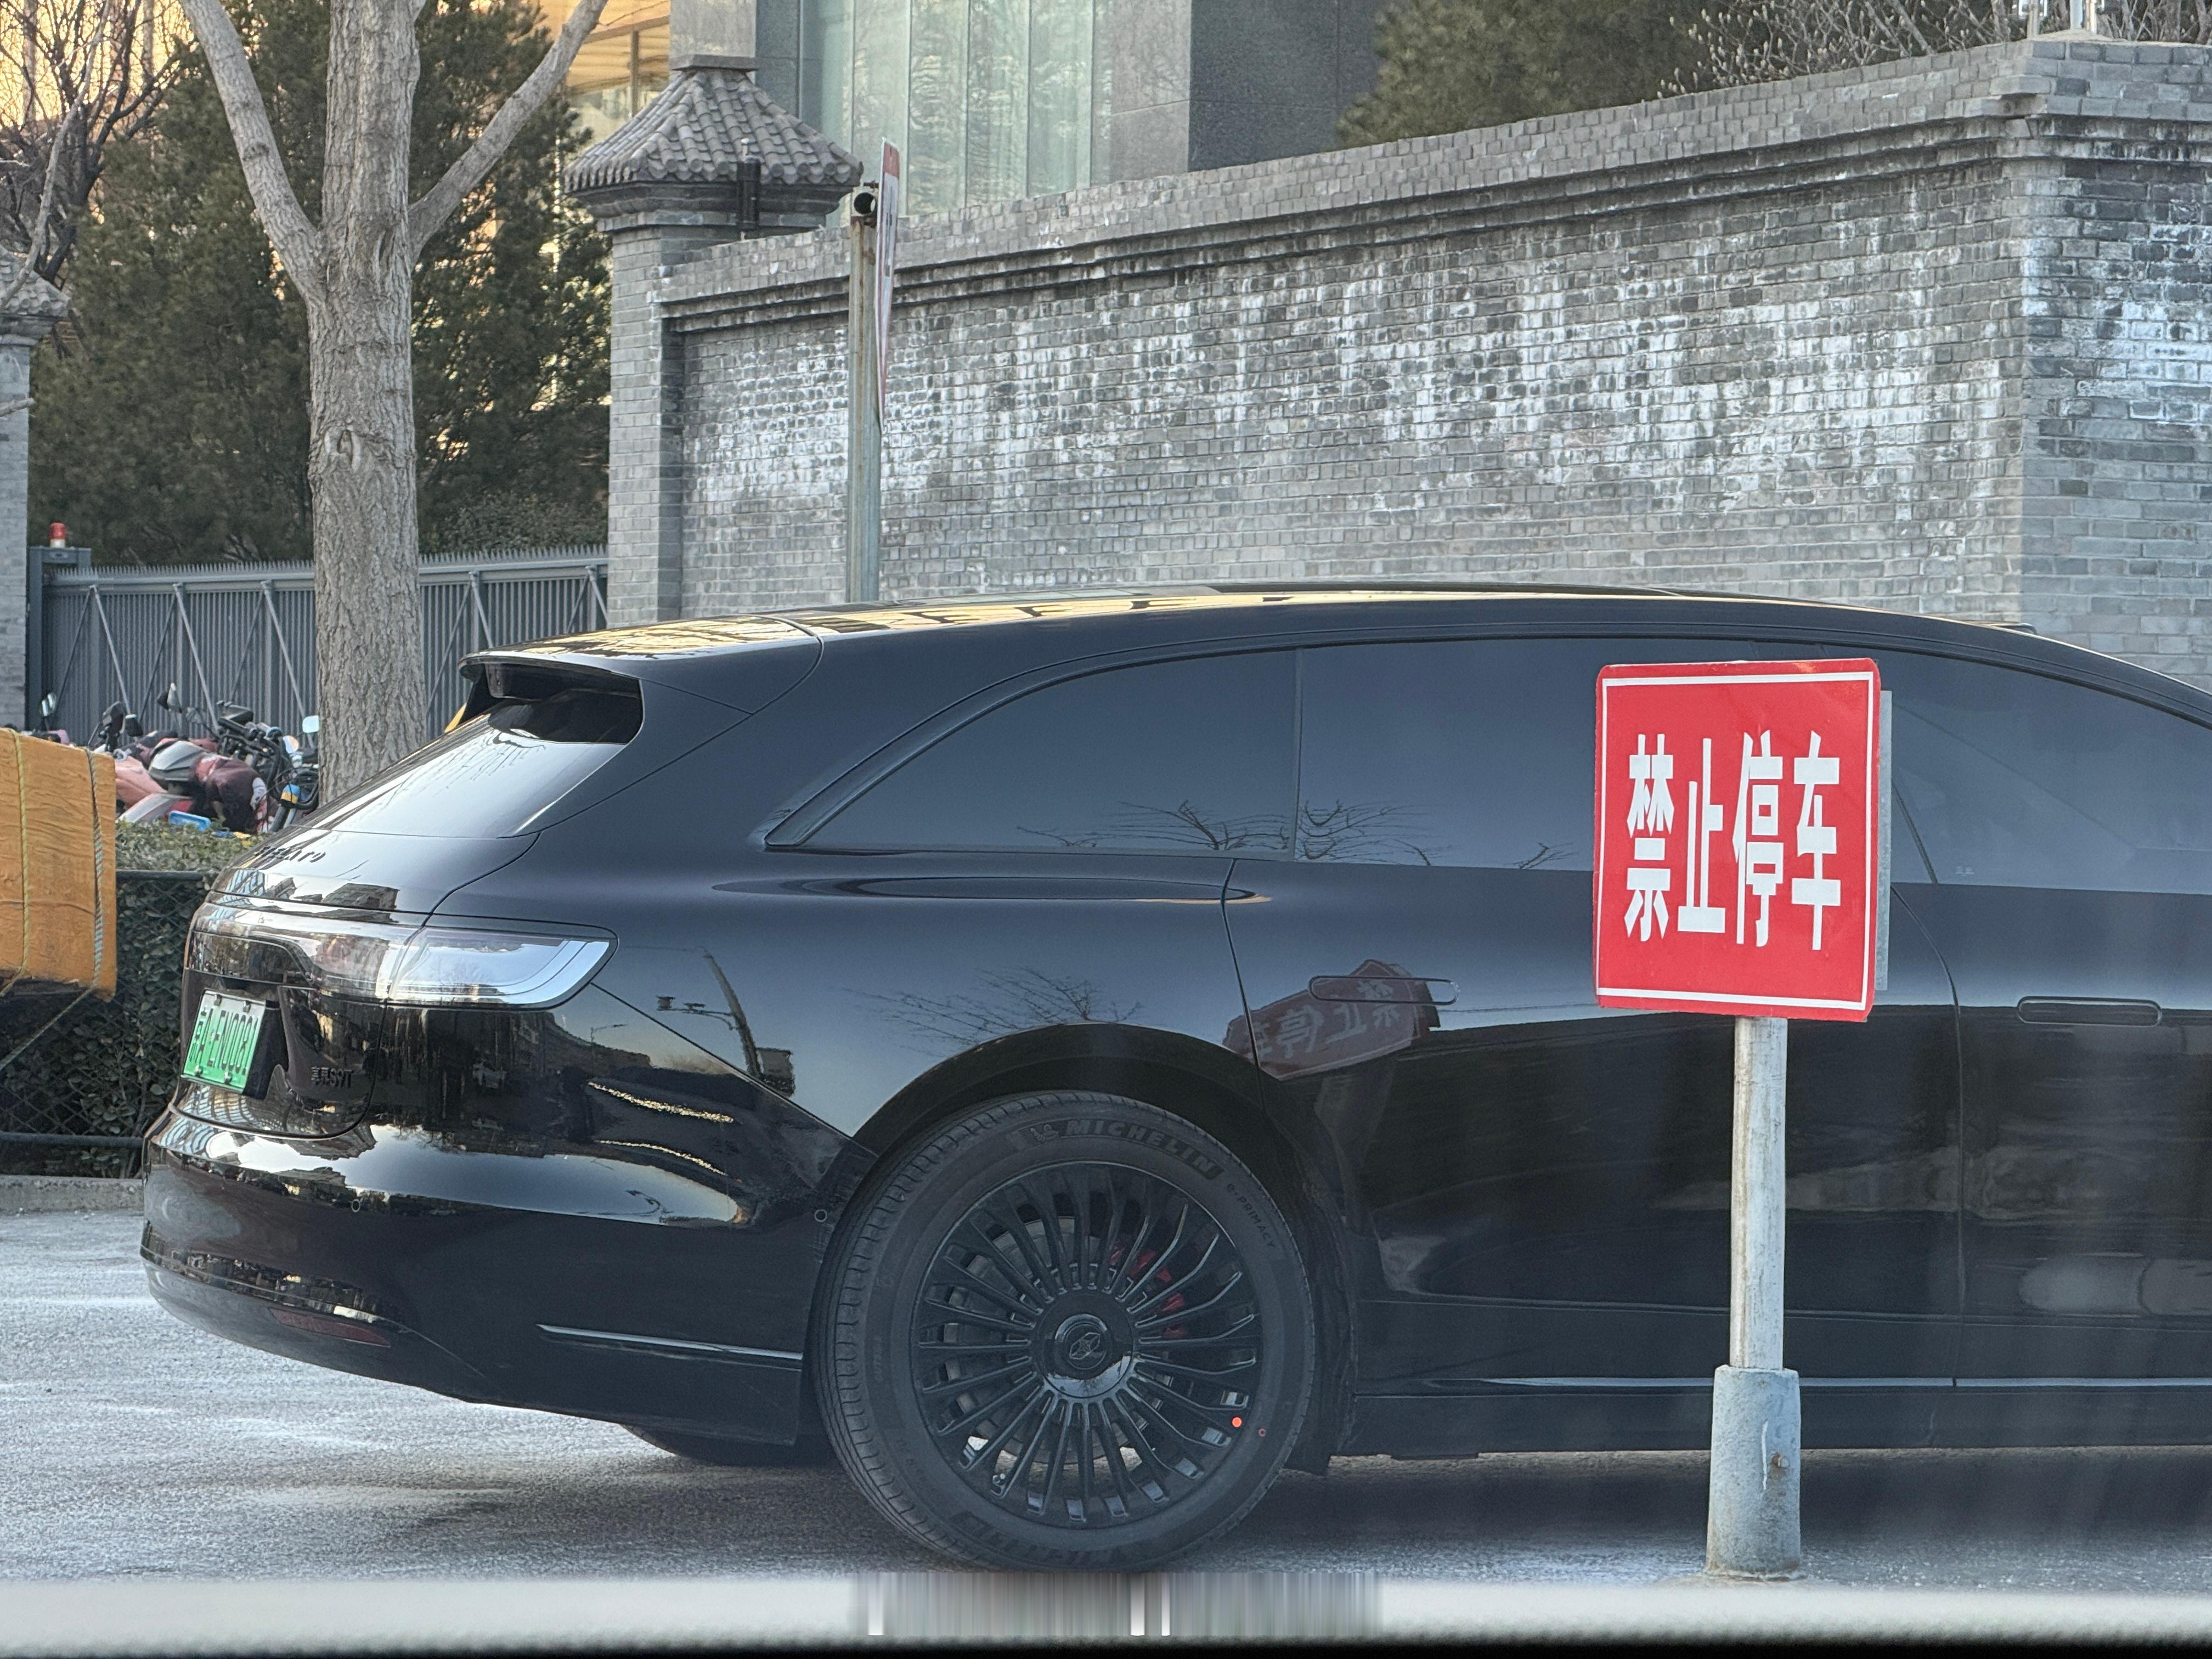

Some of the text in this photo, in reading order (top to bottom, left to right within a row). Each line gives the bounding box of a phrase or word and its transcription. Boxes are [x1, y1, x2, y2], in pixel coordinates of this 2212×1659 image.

[1624, 730, 1841, 950] 禁止停车
[1065, 1120, 1216, 1174] MICHELIN
